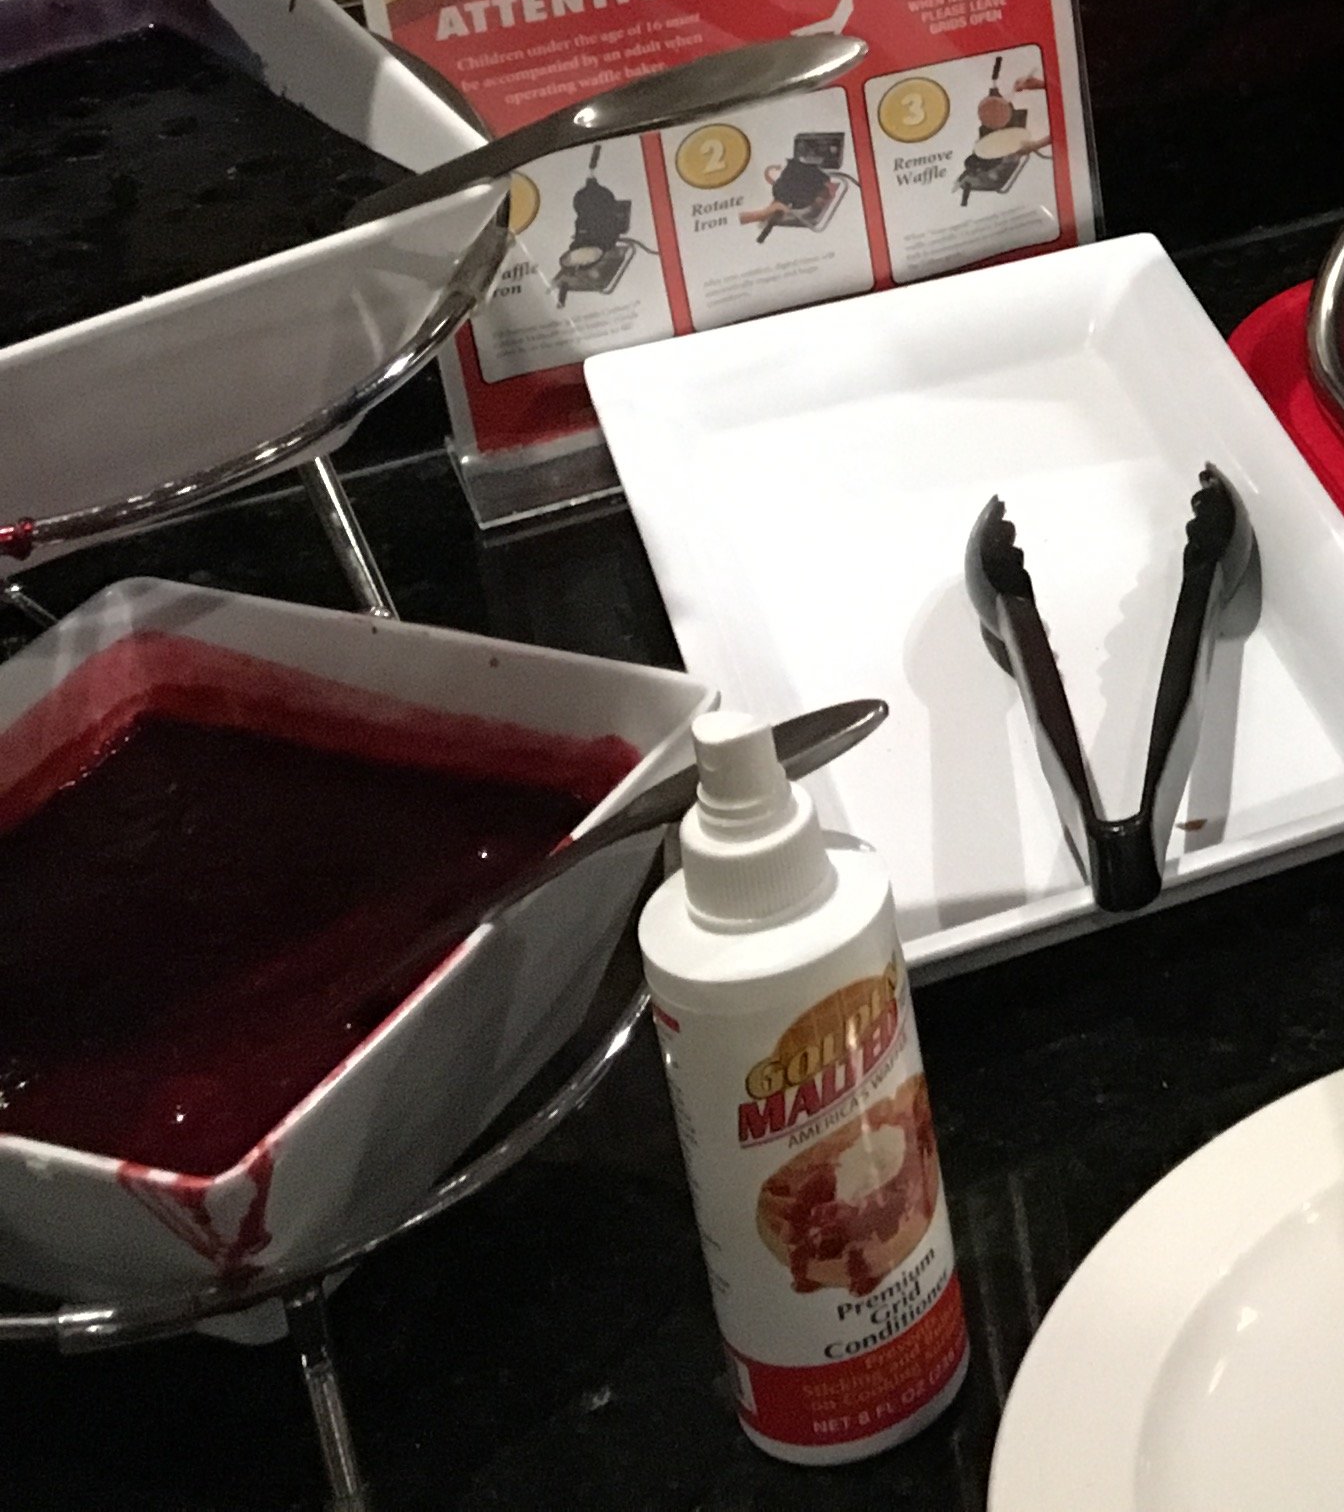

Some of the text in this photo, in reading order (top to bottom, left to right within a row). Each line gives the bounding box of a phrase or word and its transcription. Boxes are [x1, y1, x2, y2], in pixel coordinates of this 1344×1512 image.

[900, 95, 928, 127] 3
[701, 138, 728, 175] 2
[893, 149, 954, 172] Remove
[895, 165, 948, 187] Waffle
[691, 194, 744, 218] Rotate
[693, 216, 729, 233] Iron
[501, 260, 541, 282] affle
[837, 1248, 936, 1322] Premium
[870, 1280, 922, 1325] Grid
[813, 1417, 850, 1434] NET
[858, 1410, 870, 1426] 8
[876, 1401, 893, 1419] FL
